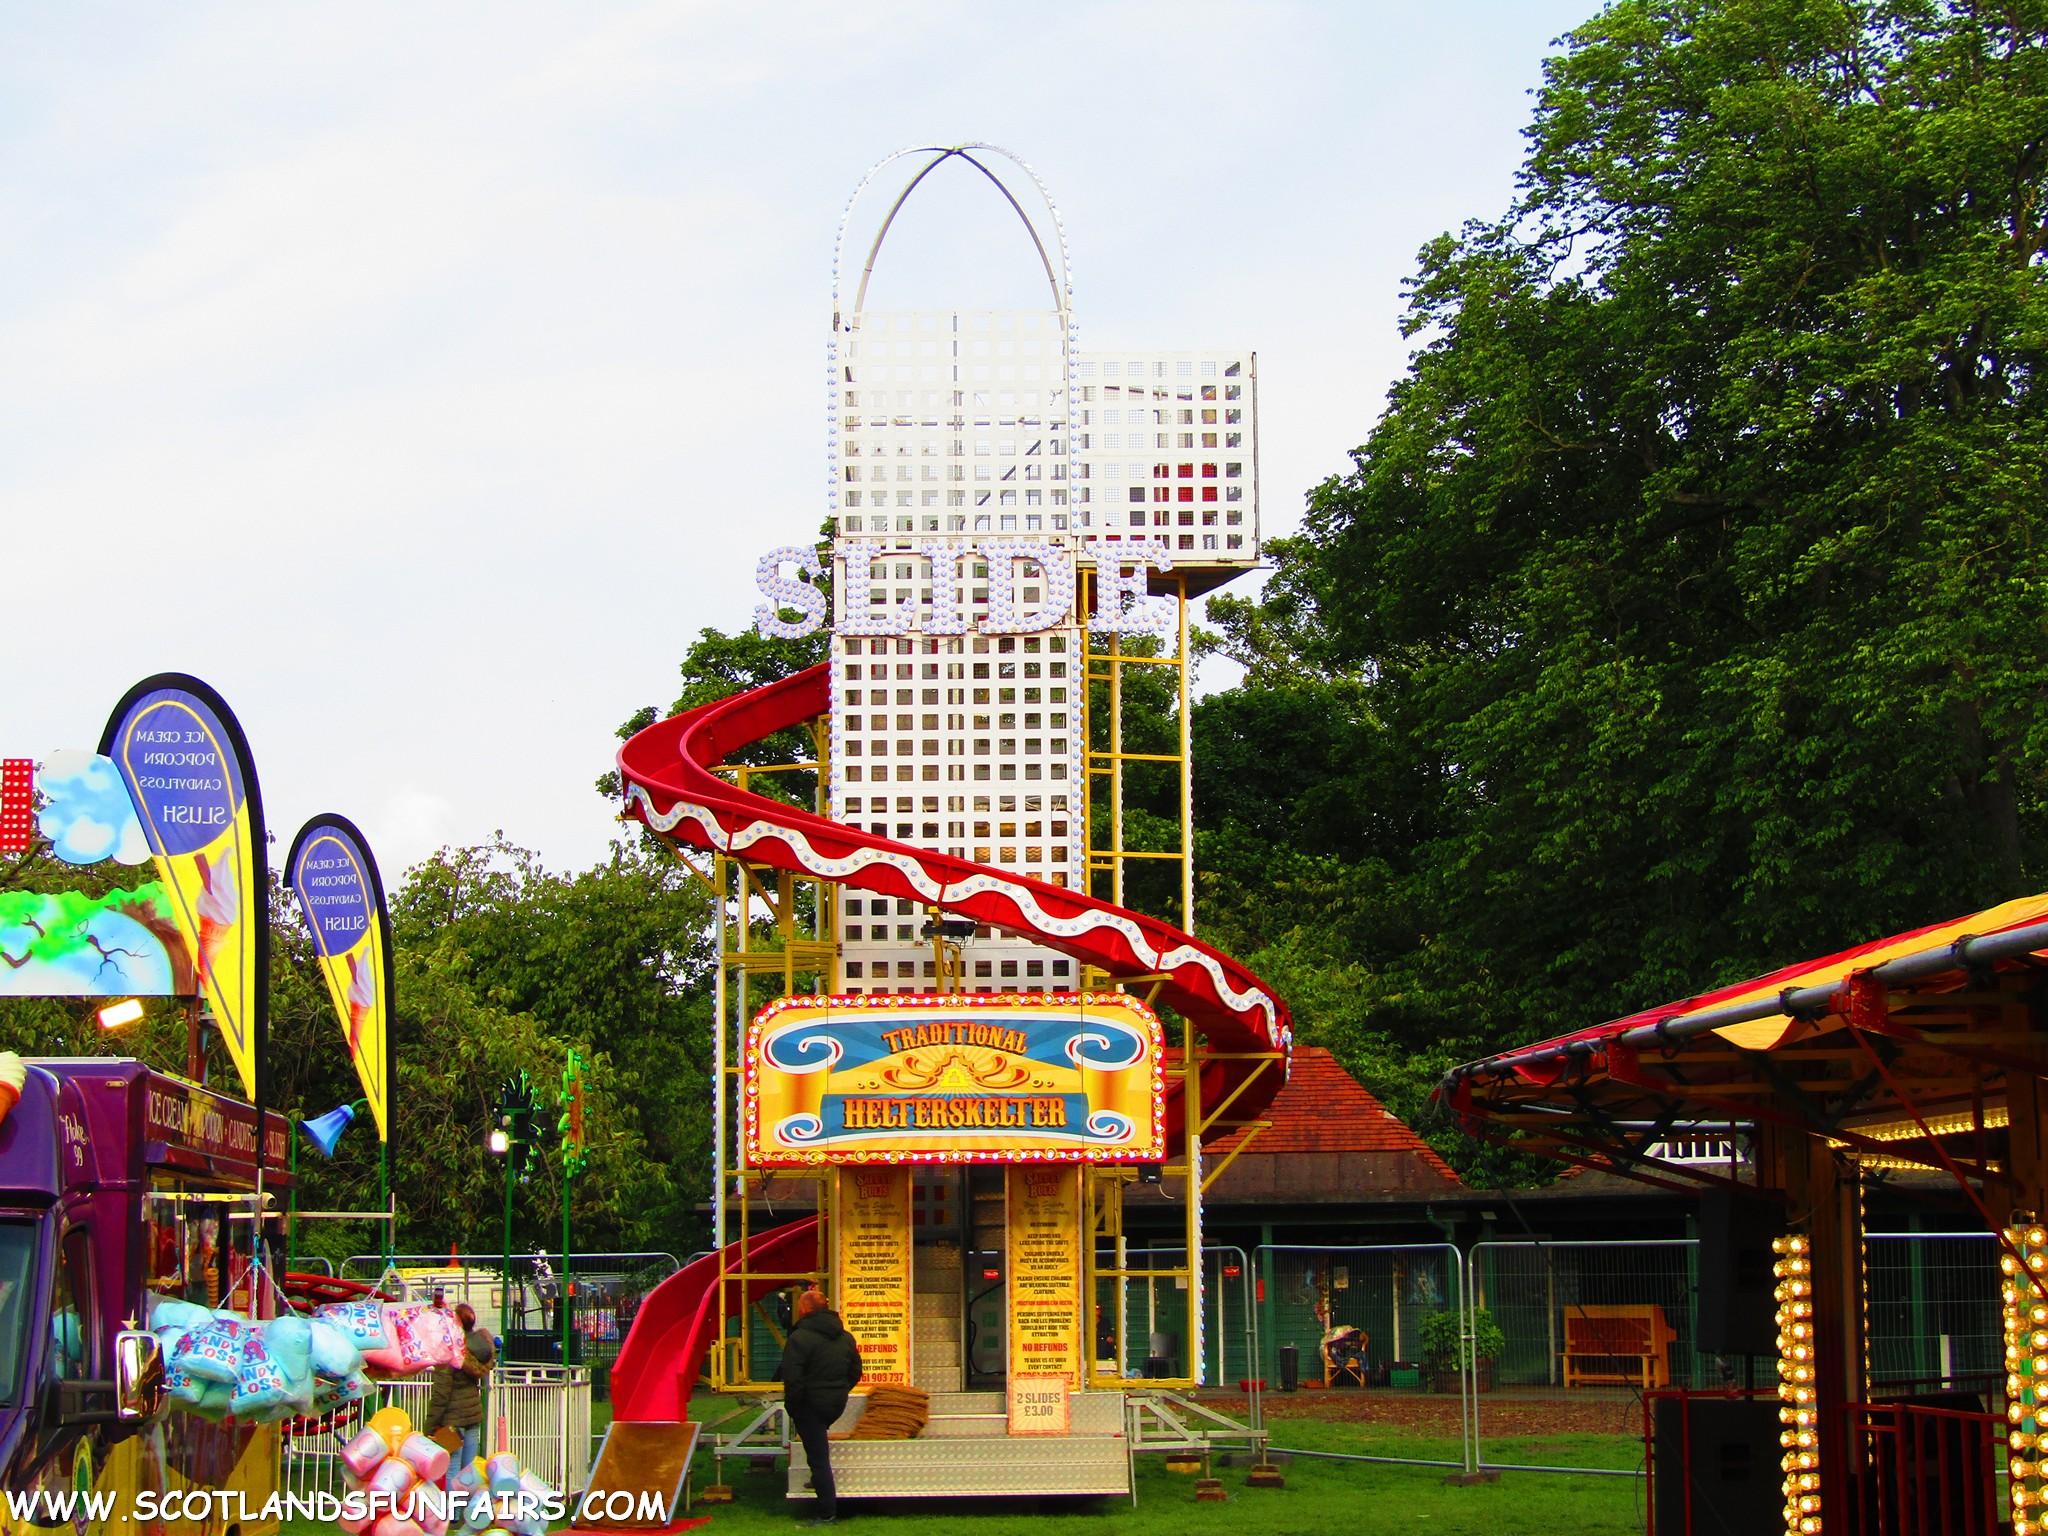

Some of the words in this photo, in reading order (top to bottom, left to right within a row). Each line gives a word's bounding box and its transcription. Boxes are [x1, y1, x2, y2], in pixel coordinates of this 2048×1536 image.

[755, 540, 1177, 641] SLIDE
[880, 1021, 1030, 1055] TRADITIONAL
[148, 1090, 162, 1126] ICE
[162, 1096, 189, 1135] CREAM
[842, 1096, 1068, 1130] HELTERSKELTER
[864, 1344, 898, 1353] REFUNDS
[1022, 1343, 1033, 1352] NO
[1034, 1343, 1068, 1352] REFUNDS
[872, 1373, 887, 1382] 903
[889, 1373, 904, 1382] 737
[231, 1377, 282, 1400] FLOSS
[1016, 1393, 1024, 1404] 2
[1025, 1393, 1061, 1404] SLIDES
[1024, 1405, 1054, 1417] £3.00
